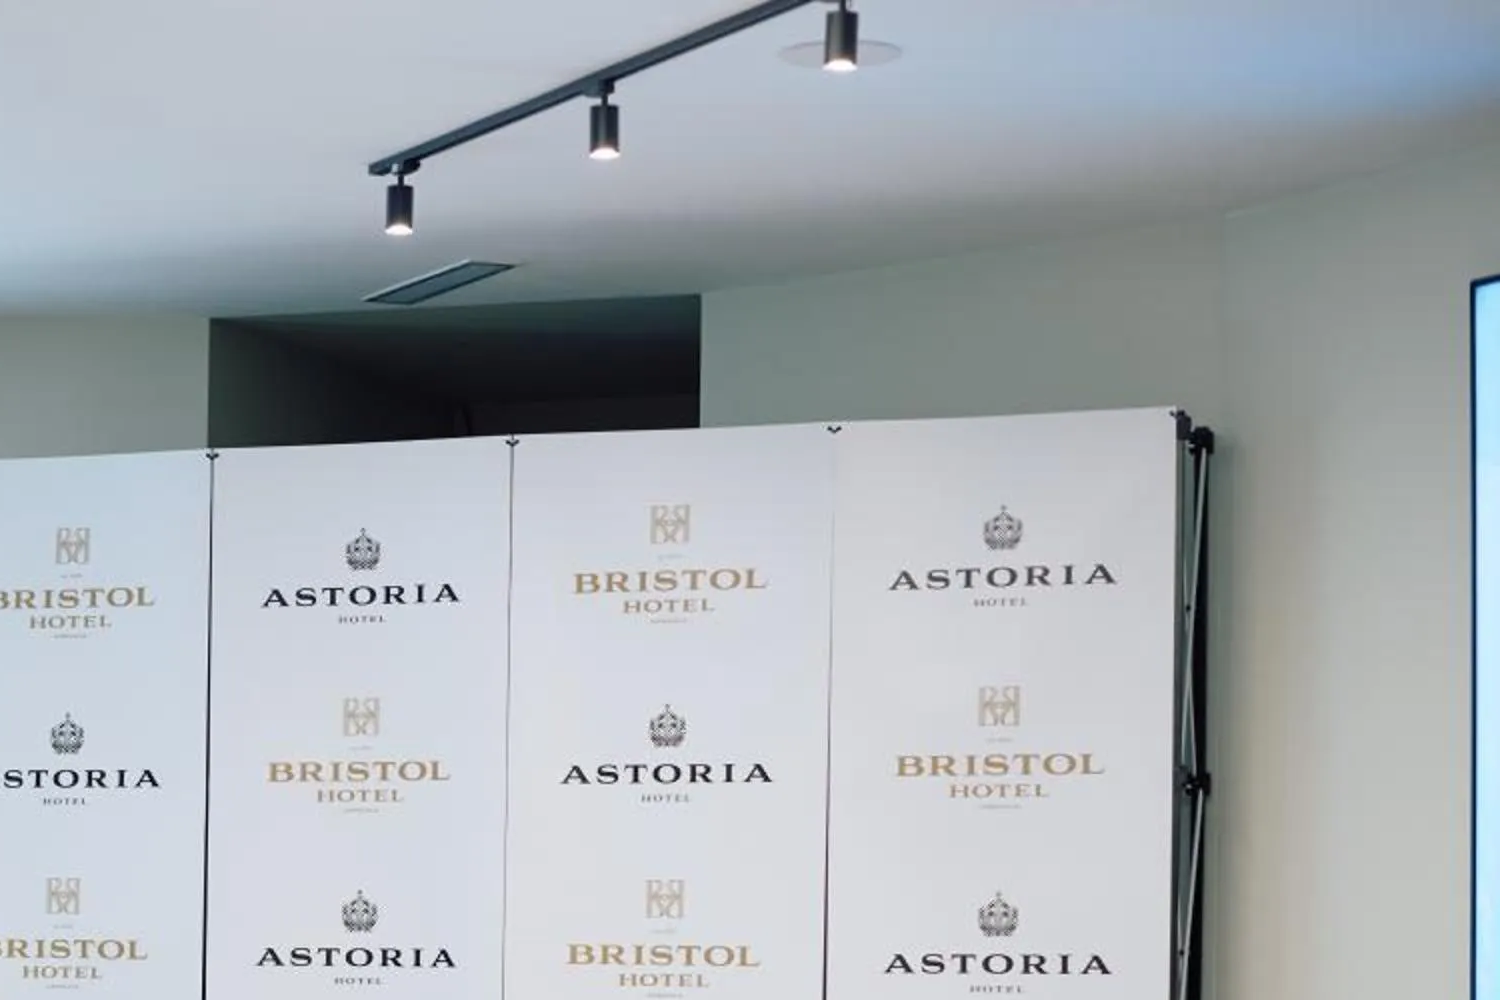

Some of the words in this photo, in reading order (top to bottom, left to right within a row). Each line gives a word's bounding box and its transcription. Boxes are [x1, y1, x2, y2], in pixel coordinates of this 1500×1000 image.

[574, 568, 766, 594] BRISTOL
[889, 564, 1116, 591] ASTORIA
[262, 584, 459, 607] ASTORIA
[973, 597, 1027, 607] HOTEL
[623, 598, 715, 614] HOTEL
[30, 615, 112, 629] HOTEL
[338, 615, 386, 624] HOTEL
[268, 761, 450, 782] BRISTOL
[896, 753, 1104, 777] BRISTOL
[561, 764, 772, 784] ASTORIA
[318, 789, 404, 803] HOTEL
[641, 793, 689, 803] HOTEL
[950, 783, 1048, 799] HOTEL
[43, 797, 87, 805] HOTEL
[257, 948, 455, 968] ASTORIA
[567, 944, 760, 967] BRISTOL
[23, 965, 102, 979] HOTEL
[885, 954, 1111, 975] ASTORIA
[334, 977, 383, 985] HOTEL
[619, 973, 708, 987] HOTEL
[970, 985, 1023, 993] HOTEL
